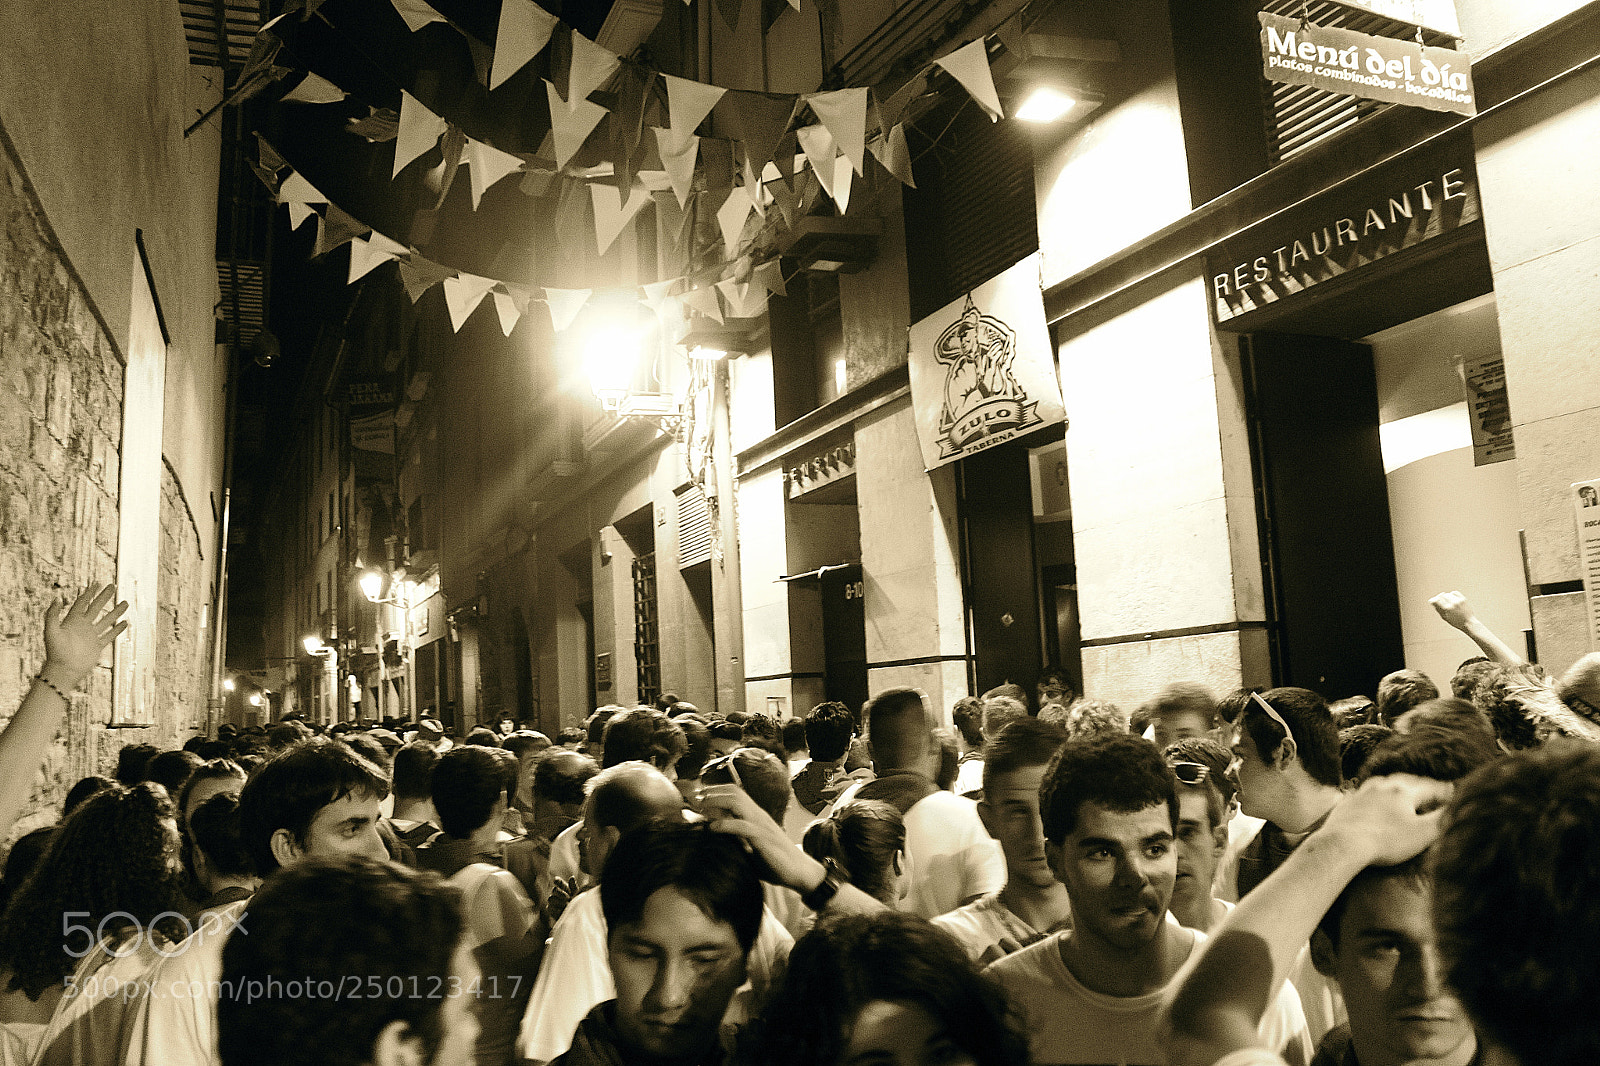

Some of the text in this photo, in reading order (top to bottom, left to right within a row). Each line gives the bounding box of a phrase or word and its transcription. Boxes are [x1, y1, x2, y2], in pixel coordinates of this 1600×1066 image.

[1267, 26, 1468, 91] Menú del día
[1269, 55, 1313, 73] platos
[1314, 66, 1396, 90] combinados
[1405, 81, 1472, 104] bocadillos
[1213, 168, 1467, 299] RESTAURANTE
[958, 409, 1011, 436] ZULO
[966, 432, 1015, 453] TABERNA
[845, 581, 864, 600] 8-10
